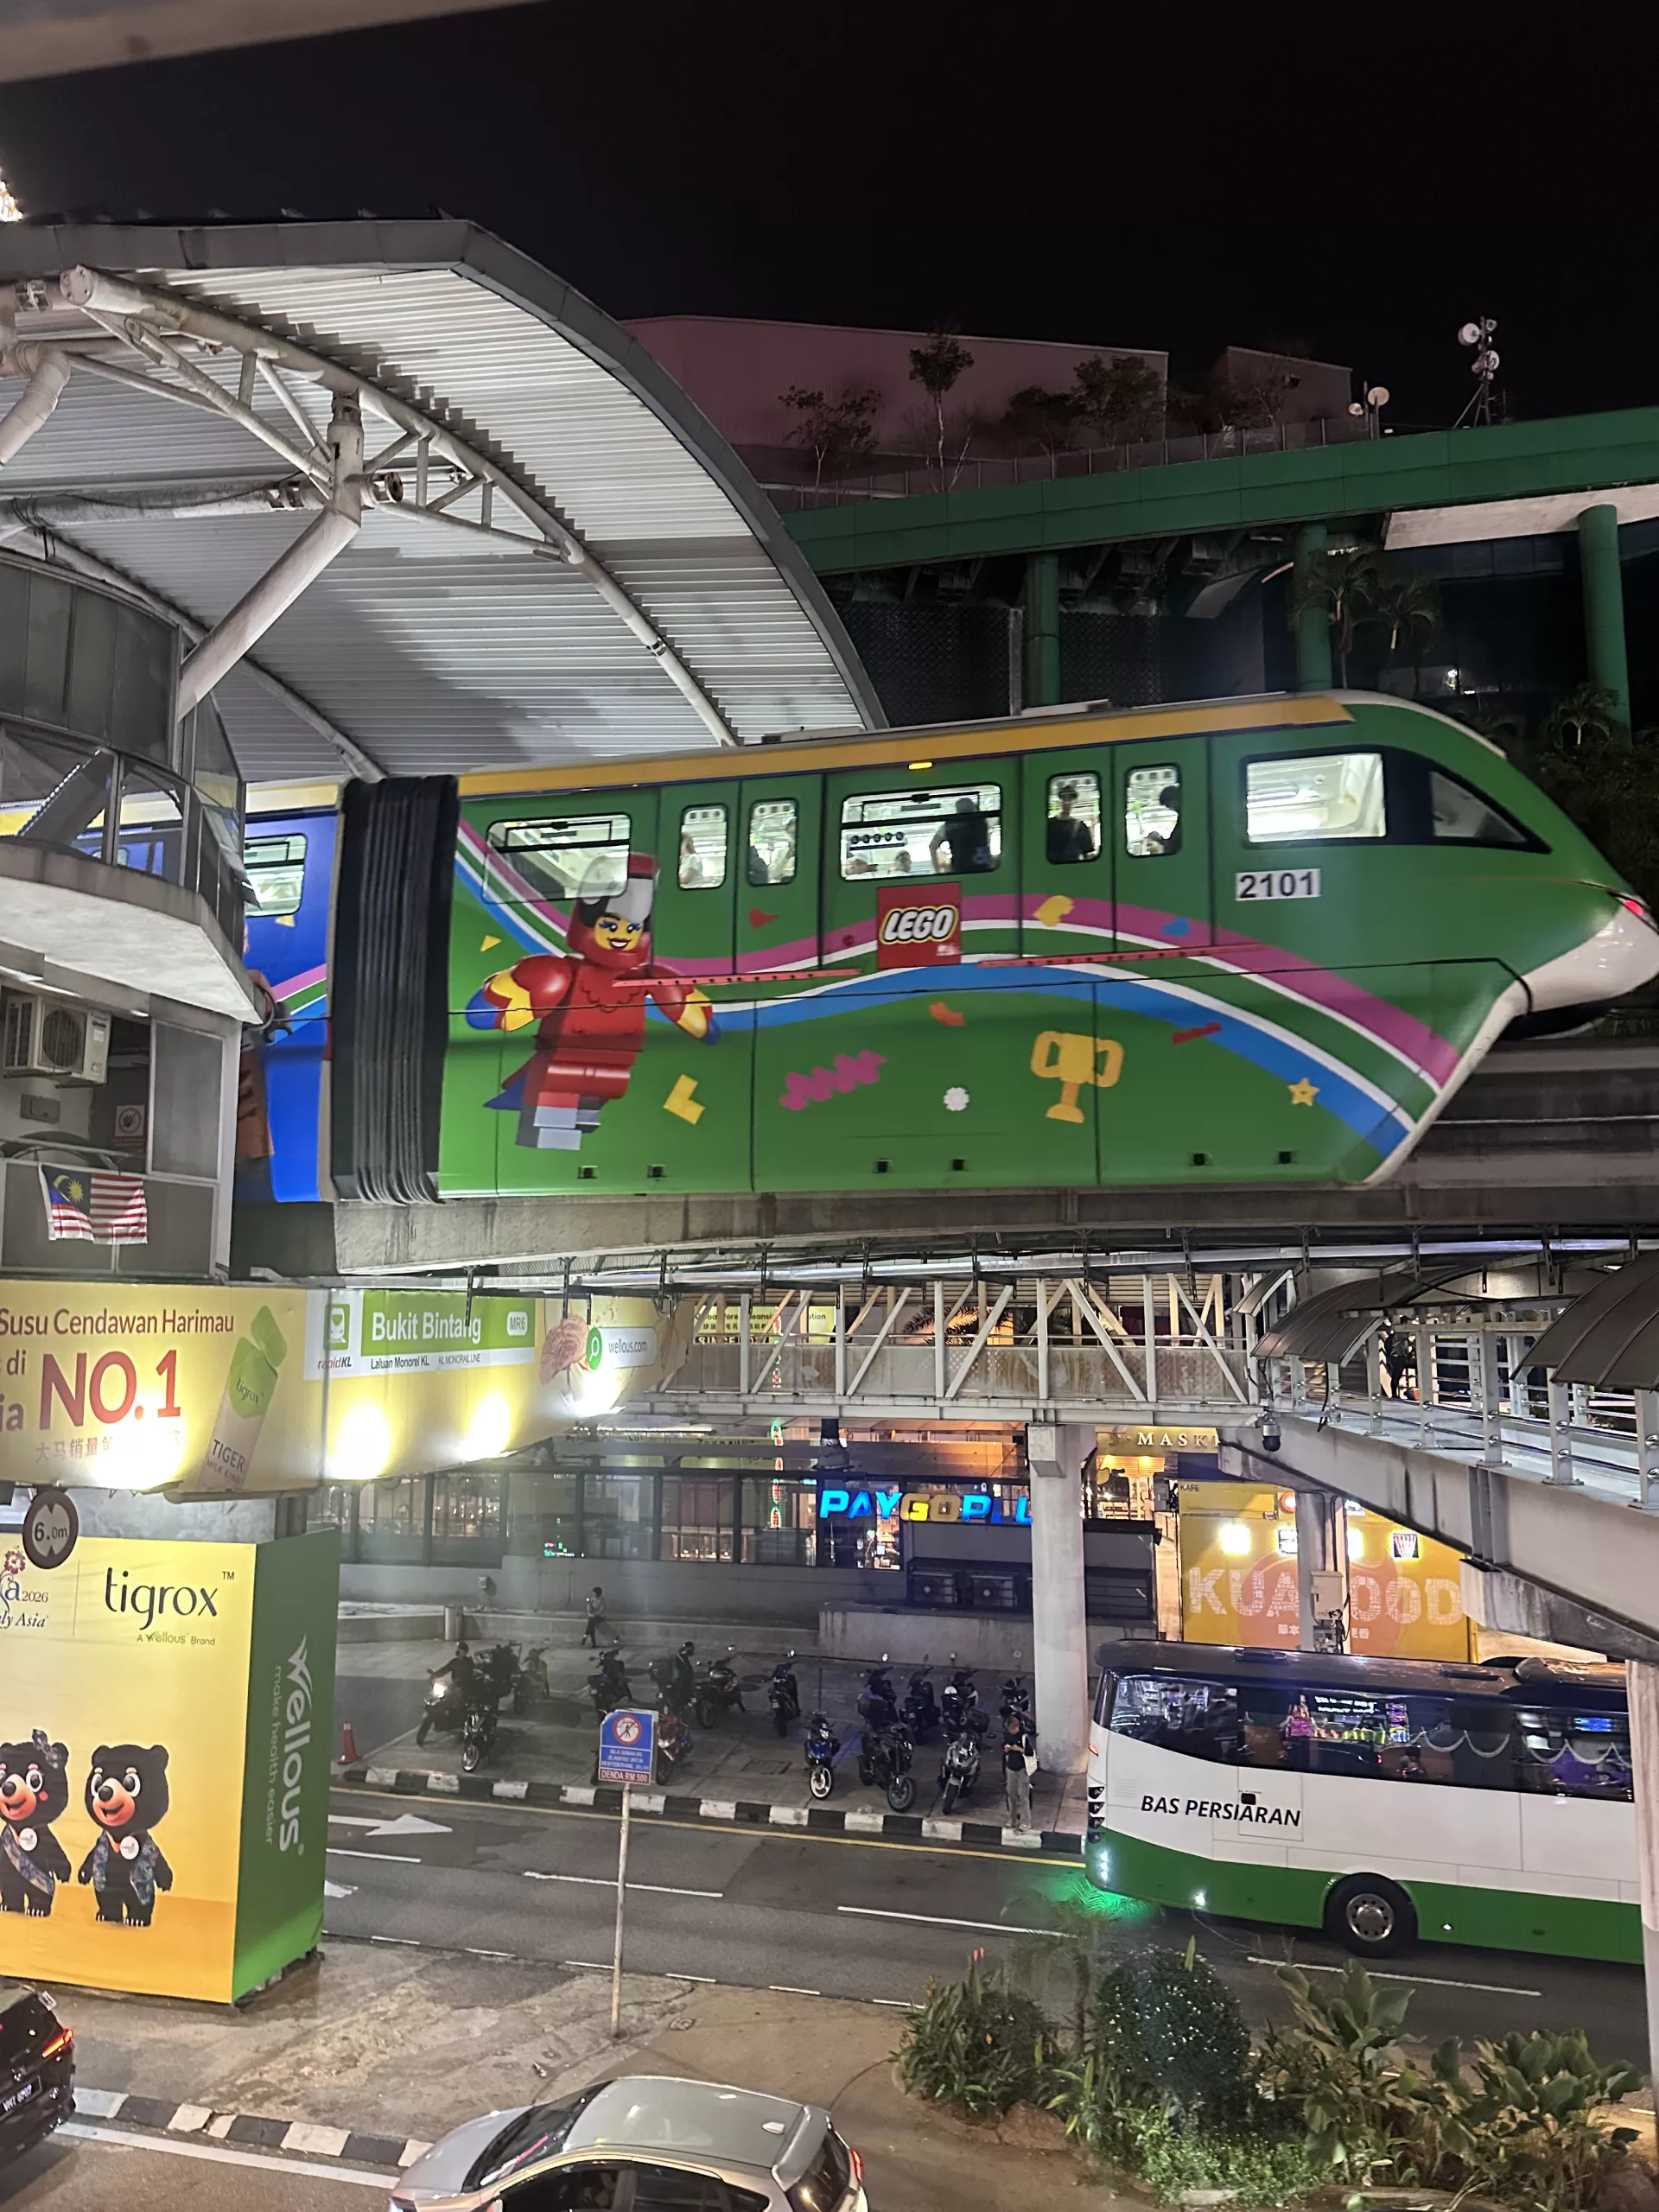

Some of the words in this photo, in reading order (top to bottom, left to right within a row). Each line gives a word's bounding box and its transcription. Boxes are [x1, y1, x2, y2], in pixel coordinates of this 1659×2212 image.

[1239, 871, 1313, 899] 2101
[881, 906, 957, 943] LEGO
[0, 1307, 48, 1336] Susu
[54, 1307, 157, 1335] Cendawan
[162, 1309, 233, 1334] Harimau
[372, 1311, 418, 1341] Bukit
[510, 1317, 526, 1331] MR6
[607, 1338, 648, 1354] wellous.com
[317, 1355, 353, 1370] rapidKL
[371, 1357, 393, 1370] Laluan
[394, 1355, 420, 1369] Monorel
[421, 1354, 429, 1366] KL
[40, 1349, 181, 1431] NO.1
[212, 1439, 245, 1473] TIGER
[1179, 1483, 1200, 1492] KAFE
[35, 1522, 67, 1542] 6.0m
[22, 1590, 49, 1604] 2026
[105, 1567, 218, 1630] tigrox
[15, 1611, 47, 1628] Asia
[137, 1634, 143, 1643] A
[190, 1637, 216, 1646] Brand
[271, 1664, 282, 1718] make
[268, 1720, 282, 1784] health
[601, 1770, 624, 1780] DENDA
[624, 1771, 636, 1781] RM
[636, 1772, 648, 1783] 500
[265, 1787, 276, 1845] easier
[1141, 1795, 1180, 1815] BAS
[1185, 1799, 1301, 1827] PERSIARAN
